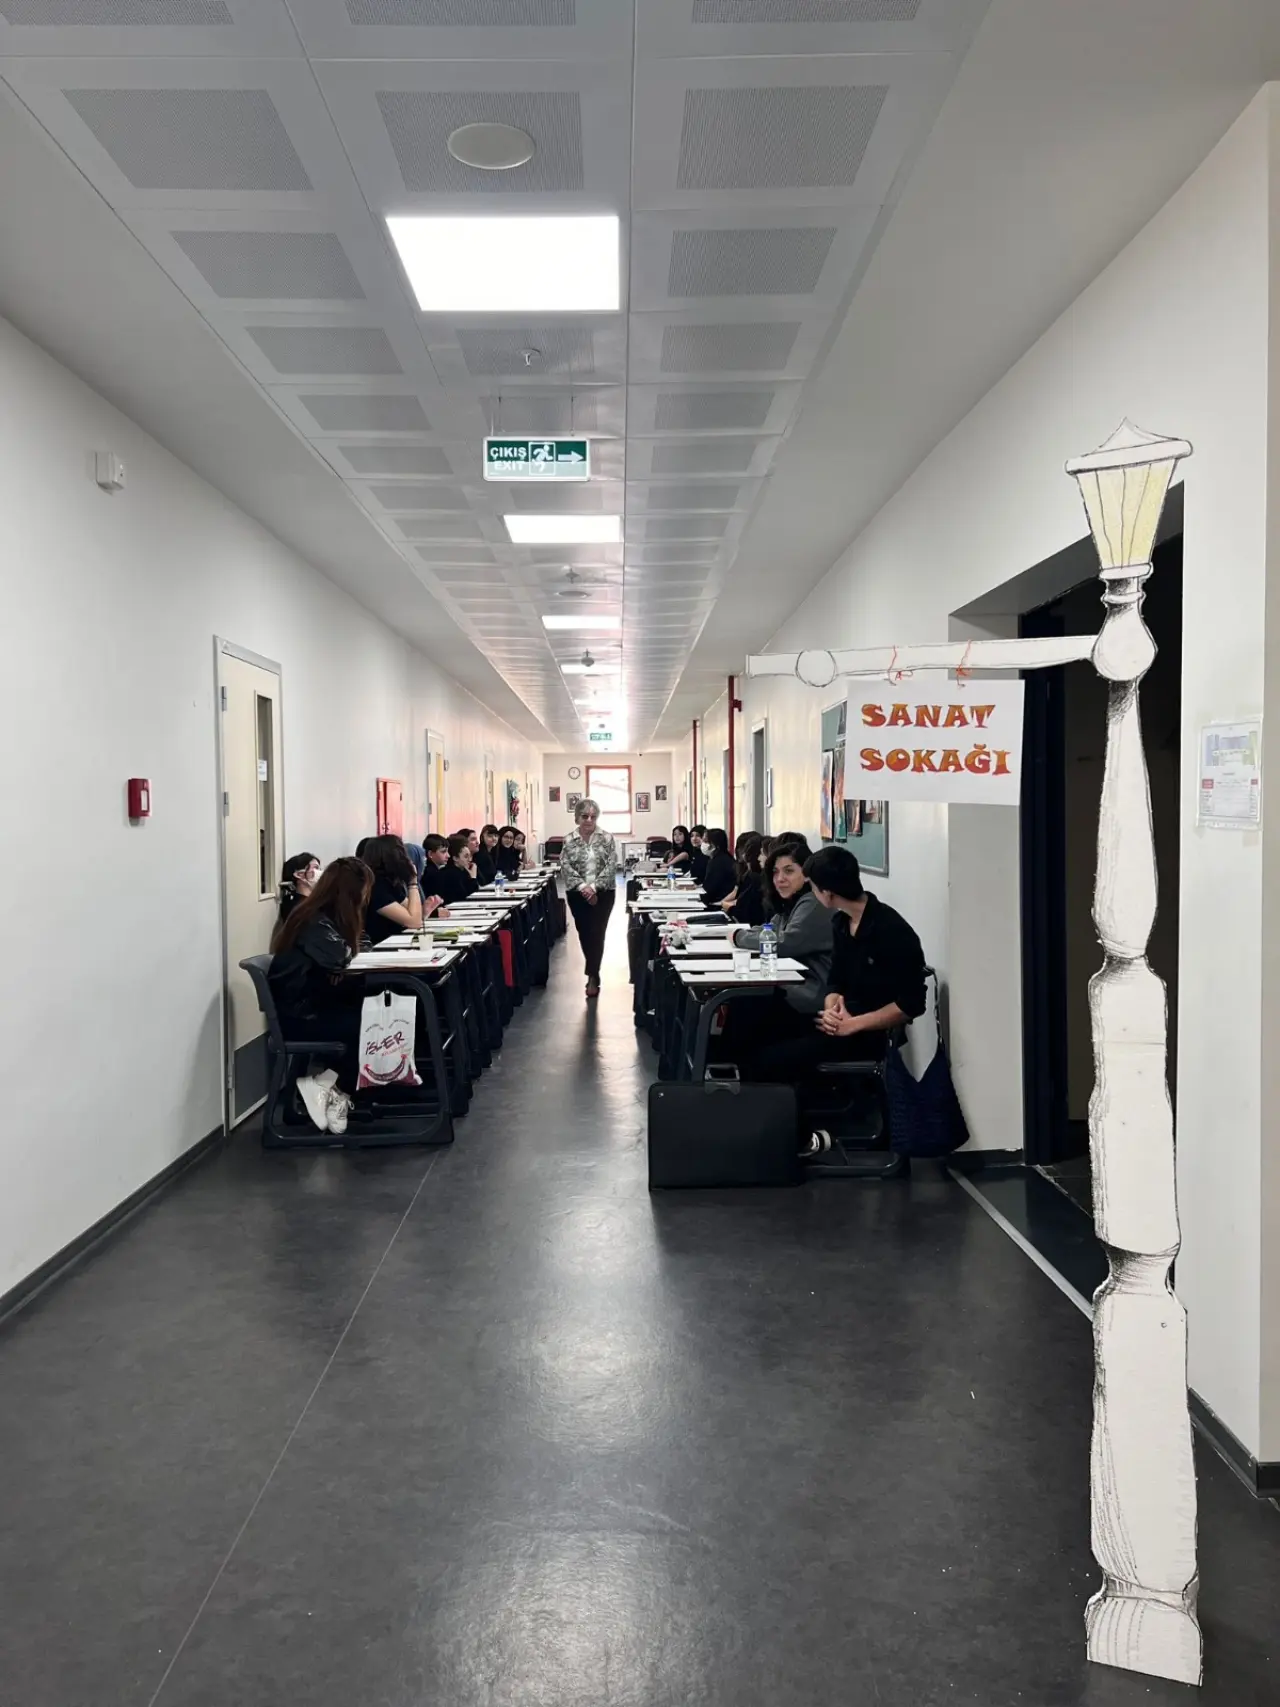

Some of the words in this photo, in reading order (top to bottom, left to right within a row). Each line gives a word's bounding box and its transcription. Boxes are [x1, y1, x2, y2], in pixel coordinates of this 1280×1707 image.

[490, 447, 527, 460] ÇIKIŞ
[494, 460, 525, 471] EXIT
[861, 703, 996, 729] SANAT
[860, 743, 1012, 776] SOKAĞI
